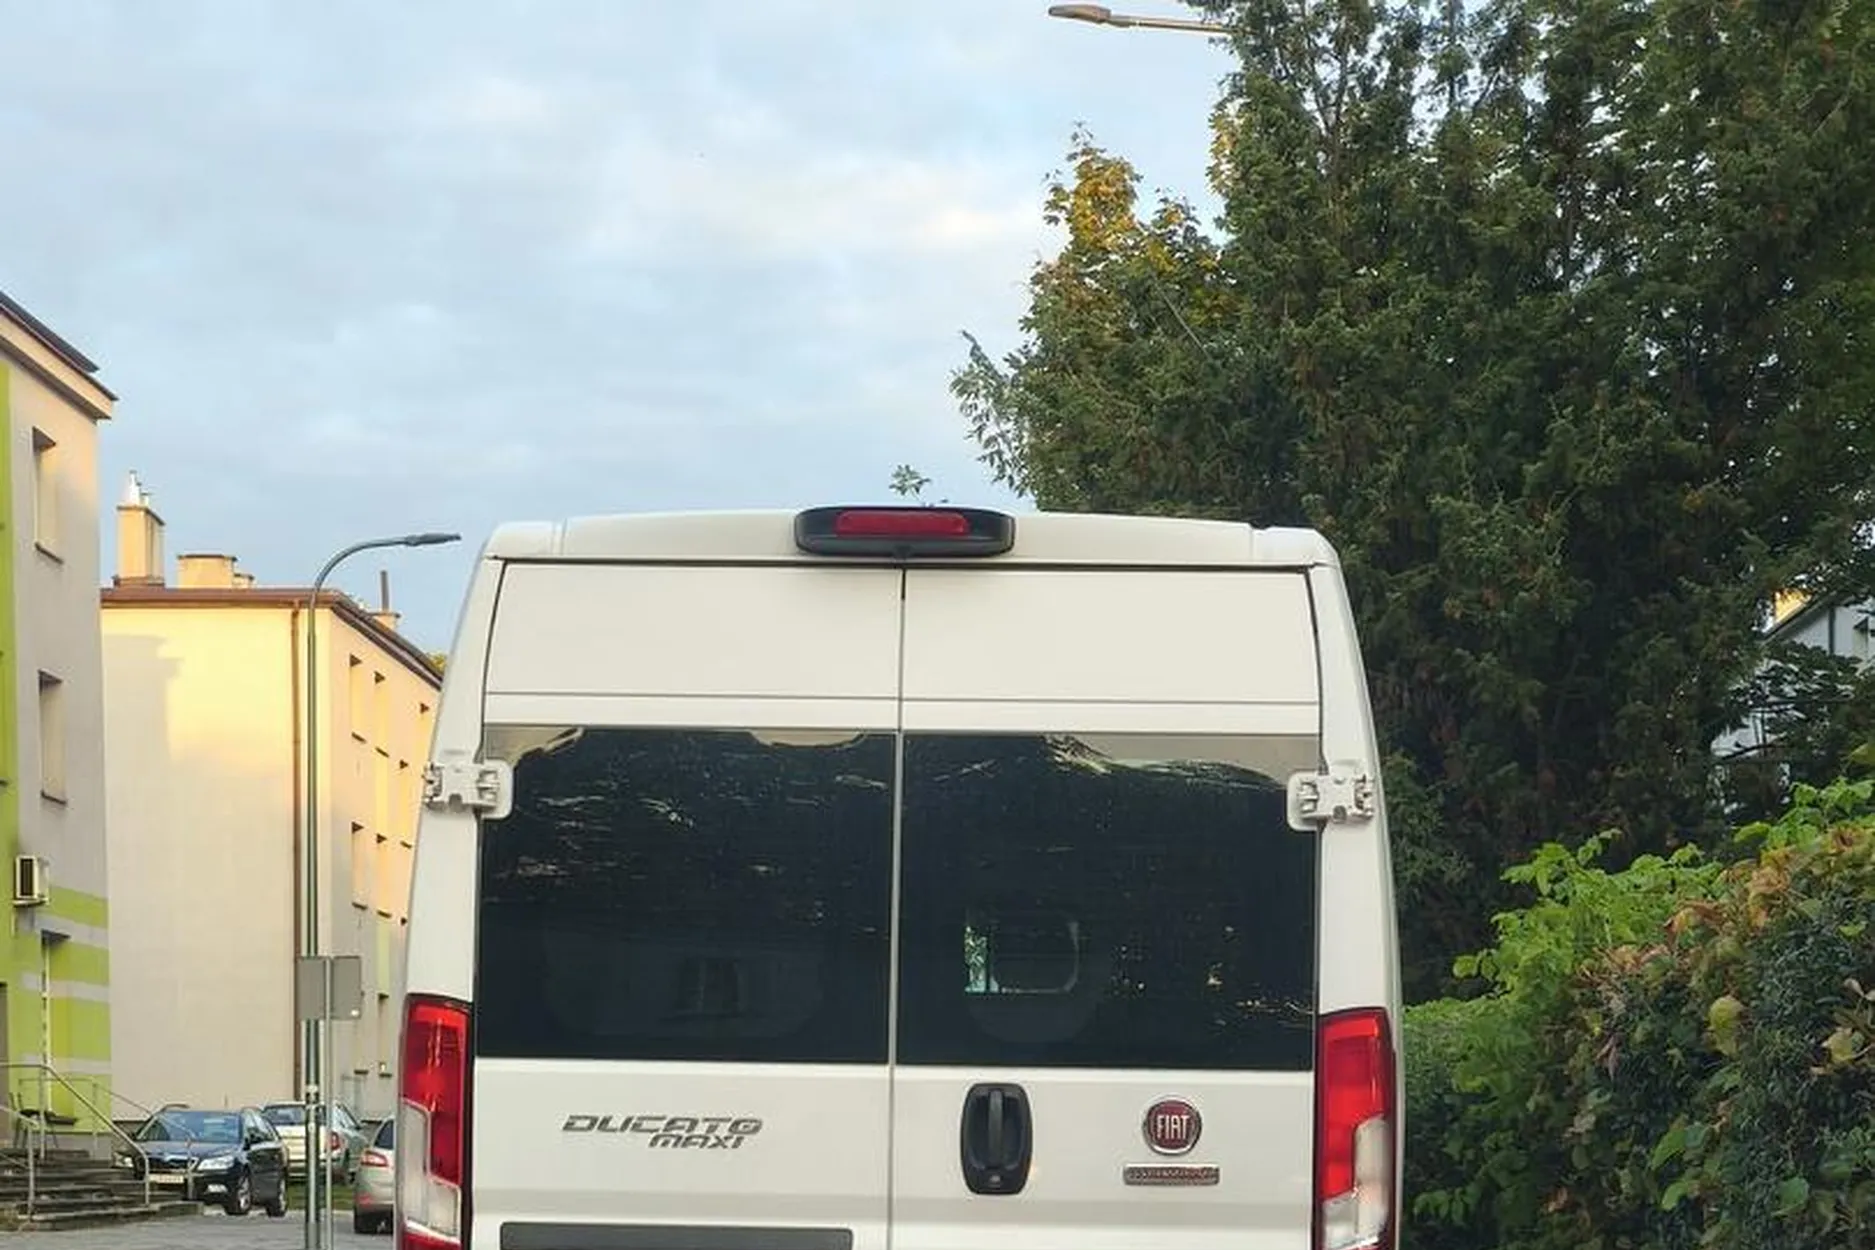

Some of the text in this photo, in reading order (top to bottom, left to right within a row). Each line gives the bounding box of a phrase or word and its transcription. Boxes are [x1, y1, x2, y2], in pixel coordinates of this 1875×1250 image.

[562, 1115, 762, 1135] DUCATO
[1156, 1114, 1190, 1139] FIAT
[649, 1134, 744, 1149] MAXI
